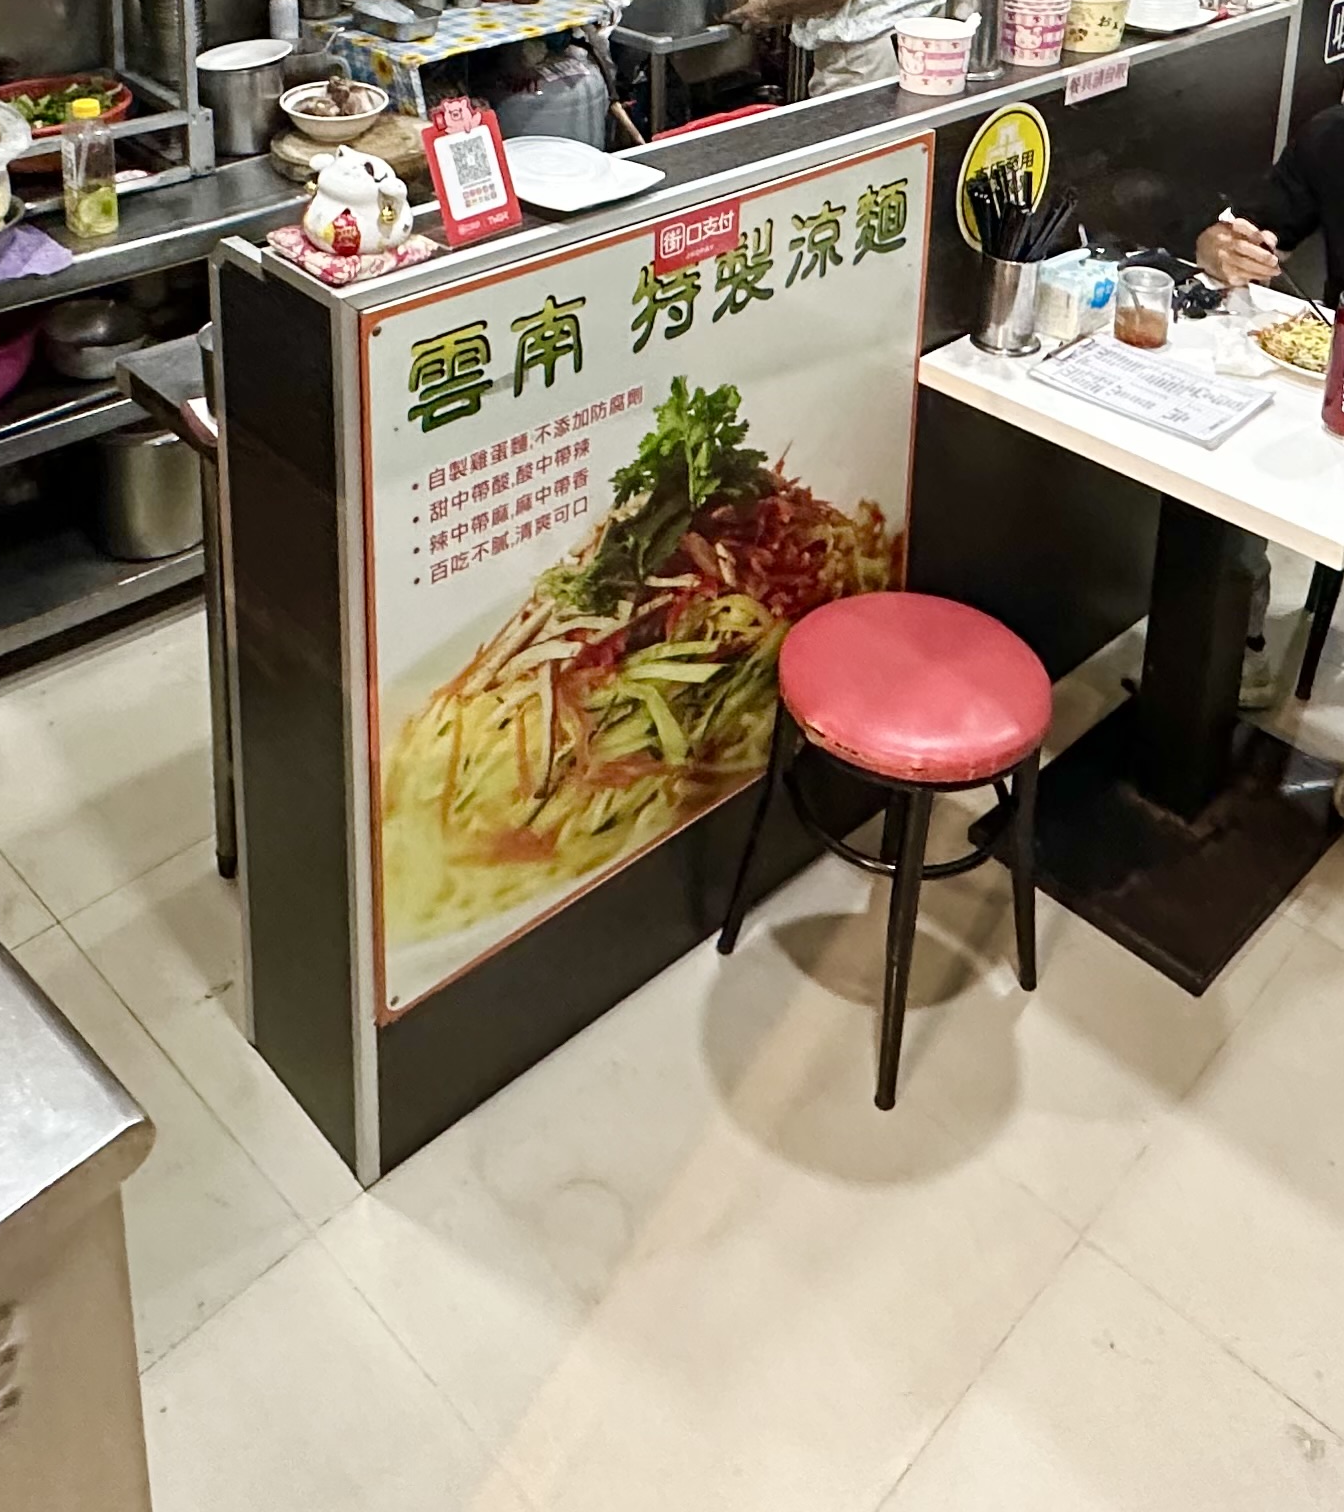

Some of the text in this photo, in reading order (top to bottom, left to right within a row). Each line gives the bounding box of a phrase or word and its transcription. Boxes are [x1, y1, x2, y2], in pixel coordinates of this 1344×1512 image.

[407, 178, 909, 433] 雲南 特製涼麵
[660, 210, 735, 259] 街口支付
